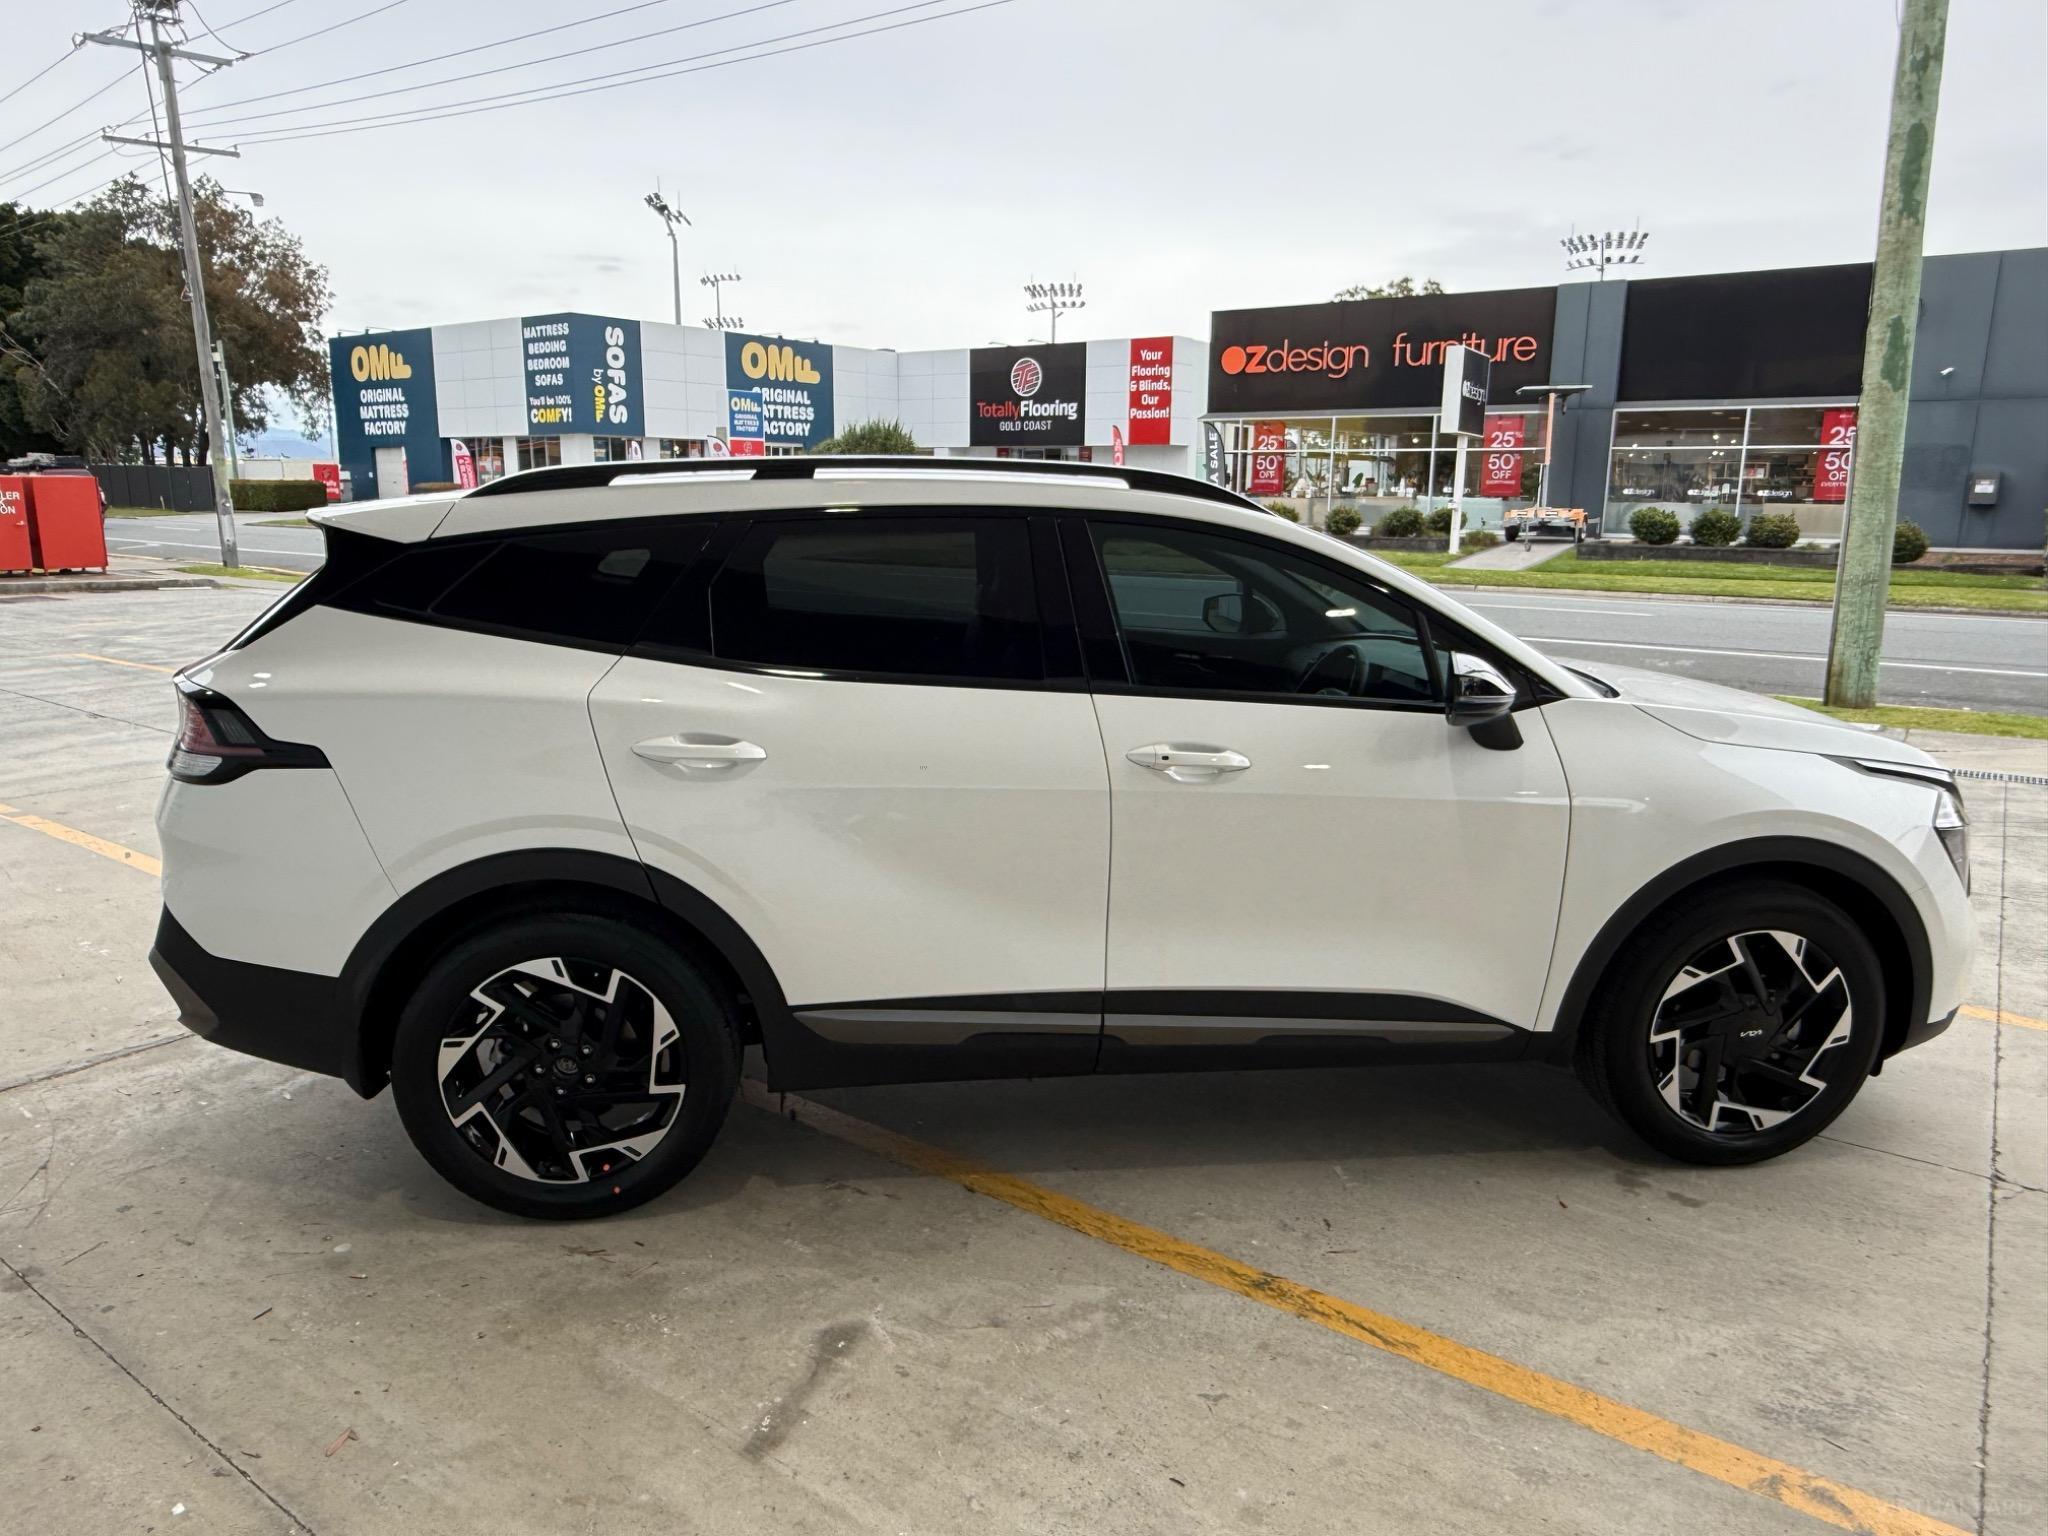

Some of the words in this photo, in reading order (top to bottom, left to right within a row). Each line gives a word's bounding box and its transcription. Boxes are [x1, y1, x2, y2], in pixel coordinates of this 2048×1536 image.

[523, 323, 570, 339] MATTRESS
[527, 339, 567, 355] BEDDING
[1140, 349, 1162, 361] Your
[350, 343, 412, 382] OMF
[527, 356, 570, 371] BEDROOM
[741, 341, 820, 384] OMF
[591, 368, 604, 385] by
[604, 326, 628, 424] SOFAS
[1131, 364, 1171, 378] Flooring
[534, 373, 564, 386] SOFAS
[1130, 381, 1138, 391] &
[360, 387, 405, 403] ORIGINAL
[1141, 393, 1159, 405] Our
[360, 403, 409, 419] MATTRESS
[530, 407, 572, 424] COMFY!
[763, 404, 815, 421] ATTRESS
[1130, 407, 1170, 419] Passion!
[364, 420, 406, 436] FACTORY
[764, 420, 811, 437] ACTORY
[999, 421, 1021, 431] GOLD
[1023, 420, 1052, 431] COAST
[1828, 426, 1857, 445] 25
[1209, 431, 1219, 469] SALE
[1824, 451, 1851, 470] 50
[1259, 470, 1276, 479] OFF
[1491, 470, 1512, 479] OFF
[1828, 470, 1847, 481] OF
